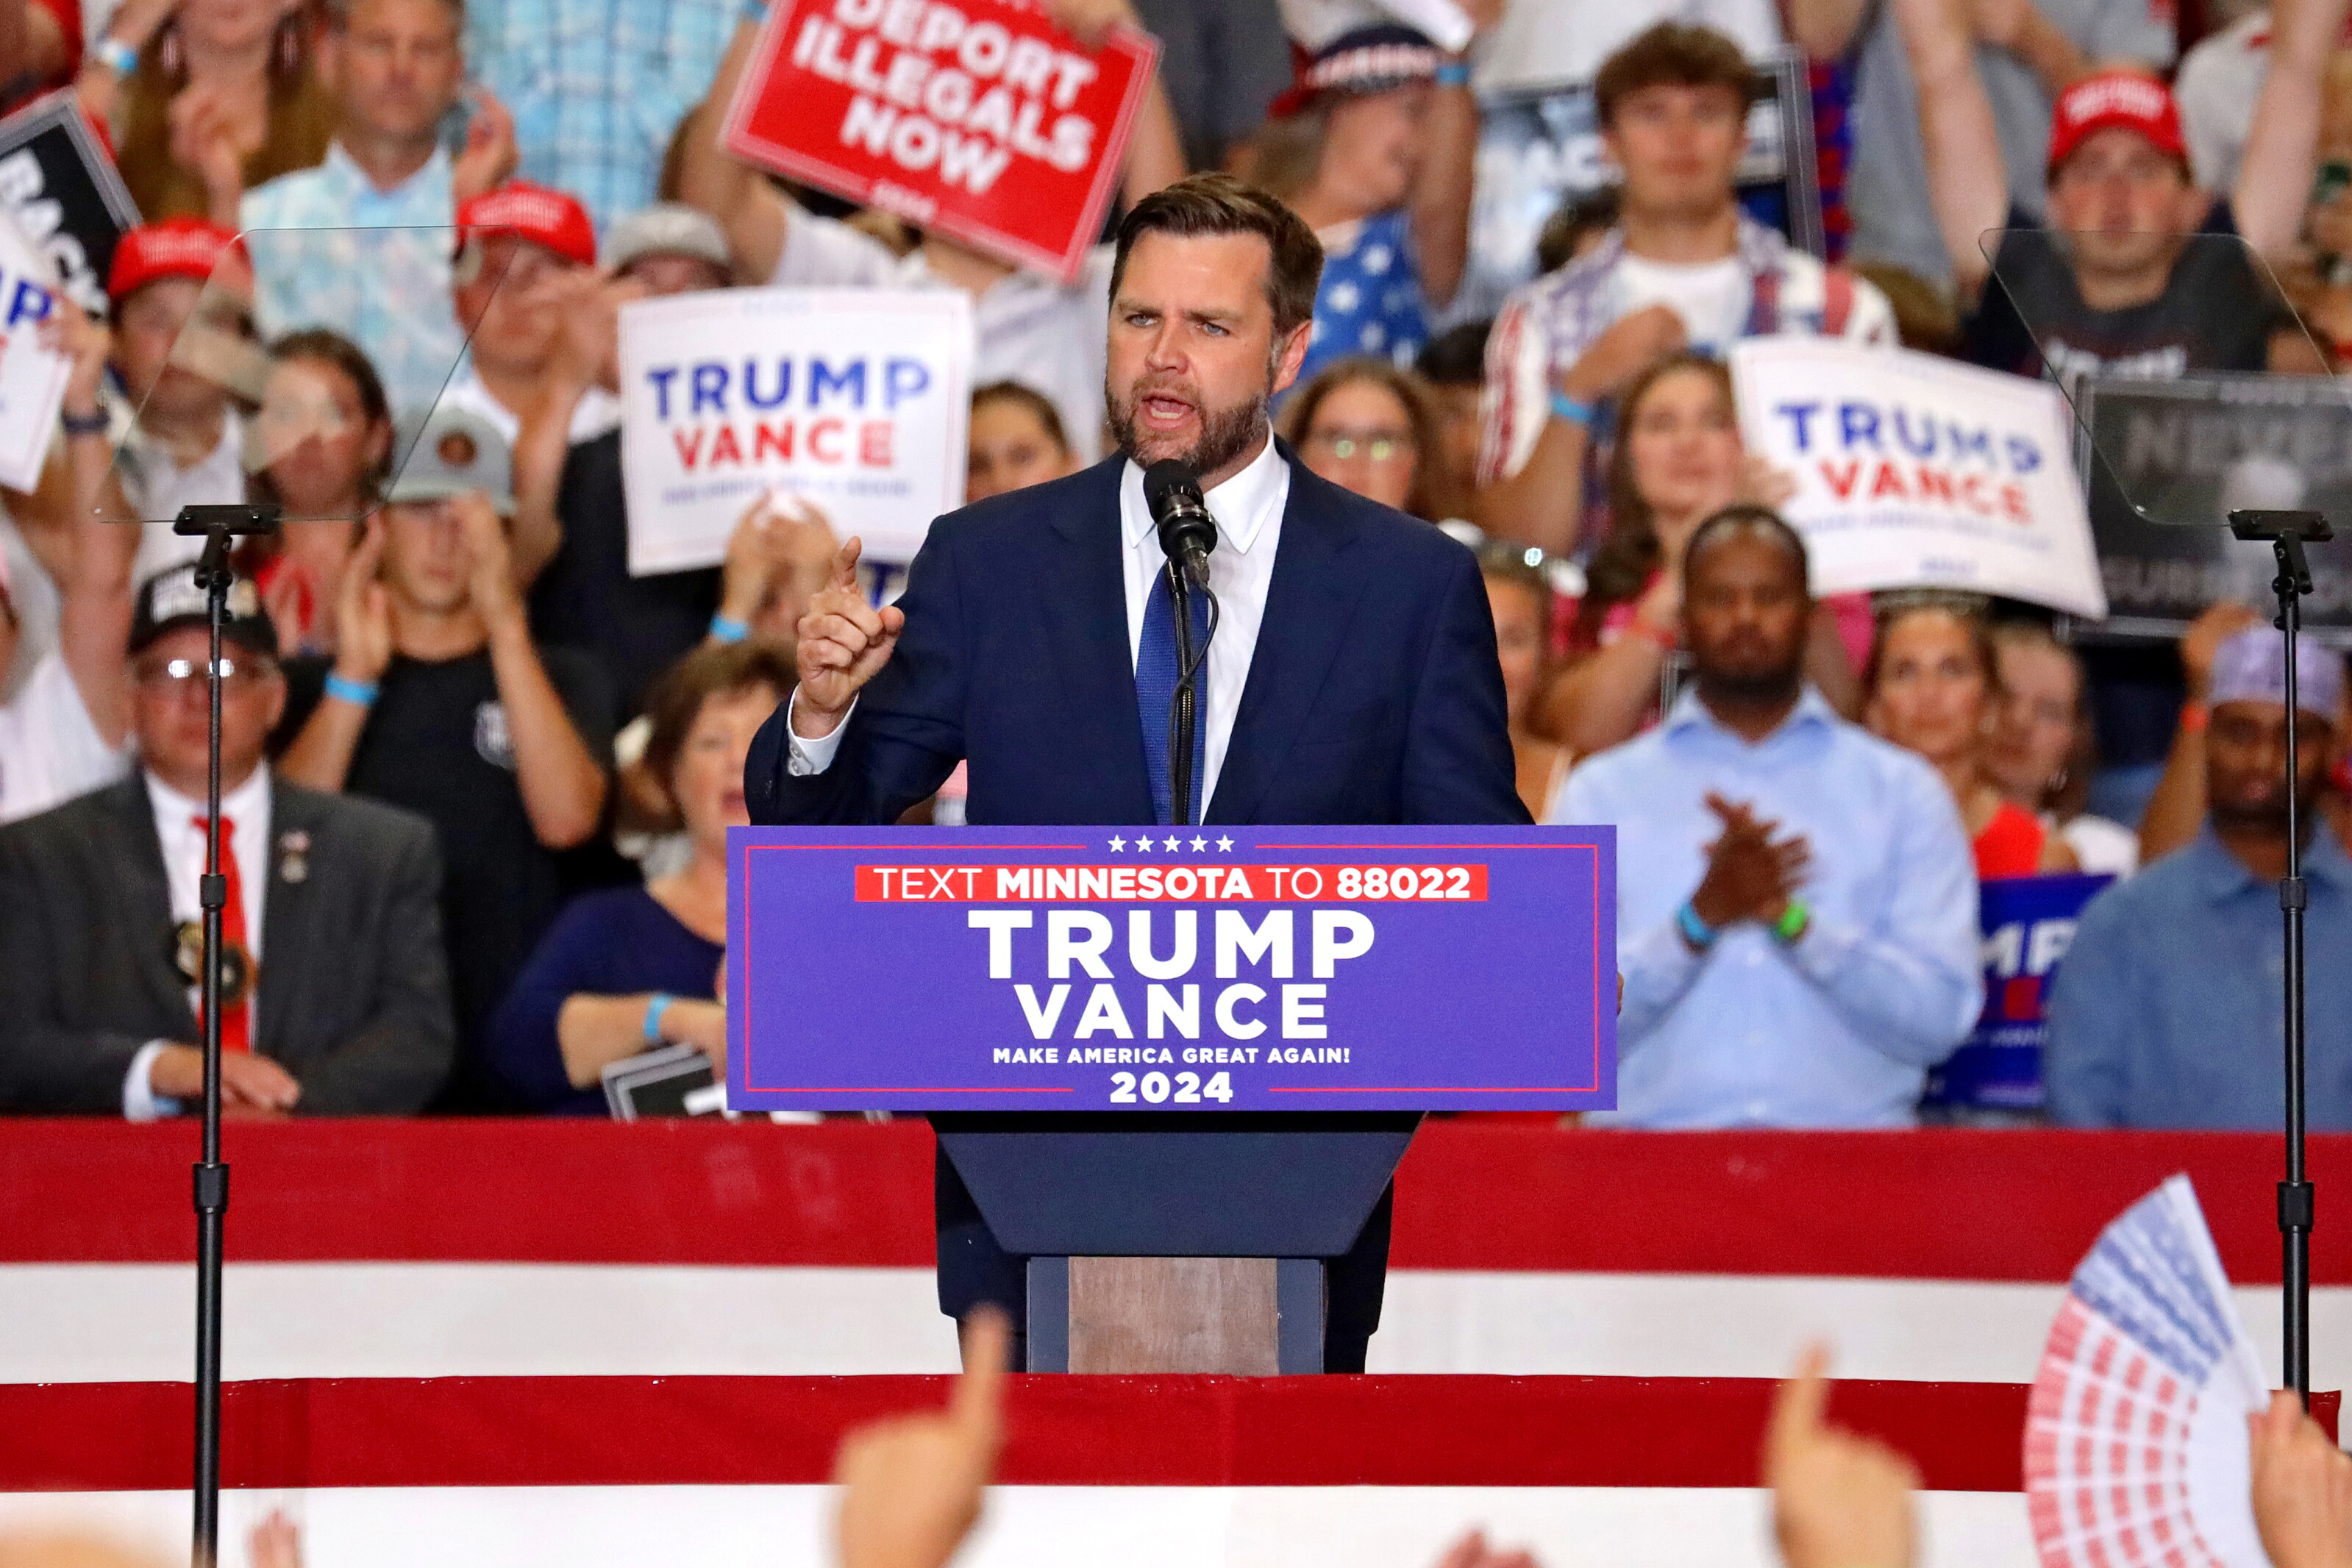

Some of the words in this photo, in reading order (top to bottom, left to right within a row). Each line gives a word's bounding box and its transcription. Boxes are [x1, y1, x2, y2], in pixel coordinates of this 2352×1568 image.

[833, 0, 1100, 109] DEPORT
[793, 15, 1096, 172] ILLEGALS
[840, 93, 1012, 195] NOW
[646, 350, 932, 423] TRUMP
[671, 413, 897, 474] VANCE
[1773, 397, 2046, 475] TRUMP
[2127, 406, 2352, 480] NEVE
[1817, 455, 2037, 528] VANCE
[874, 869, 982, 899] TEXT
[997, 868, 1253, 899] MINNESOTA
[1266, 868, 1322, 899] TO
[1337, 868, 1470, 899] 88022
[968, 910, 1375, 980] TRUMP
[1013, 983, 1328, 1040] VANCE
[994, 1048, 1058, 1063] MAKE
[1067, 1048, 1173, 1063] AMERICA
[1183, 1048, 1258, 1063] GREAT
[1267, 1048, 1350, 1063] AGAIN!
[1110, 1072, 1233, 1103] 2024
